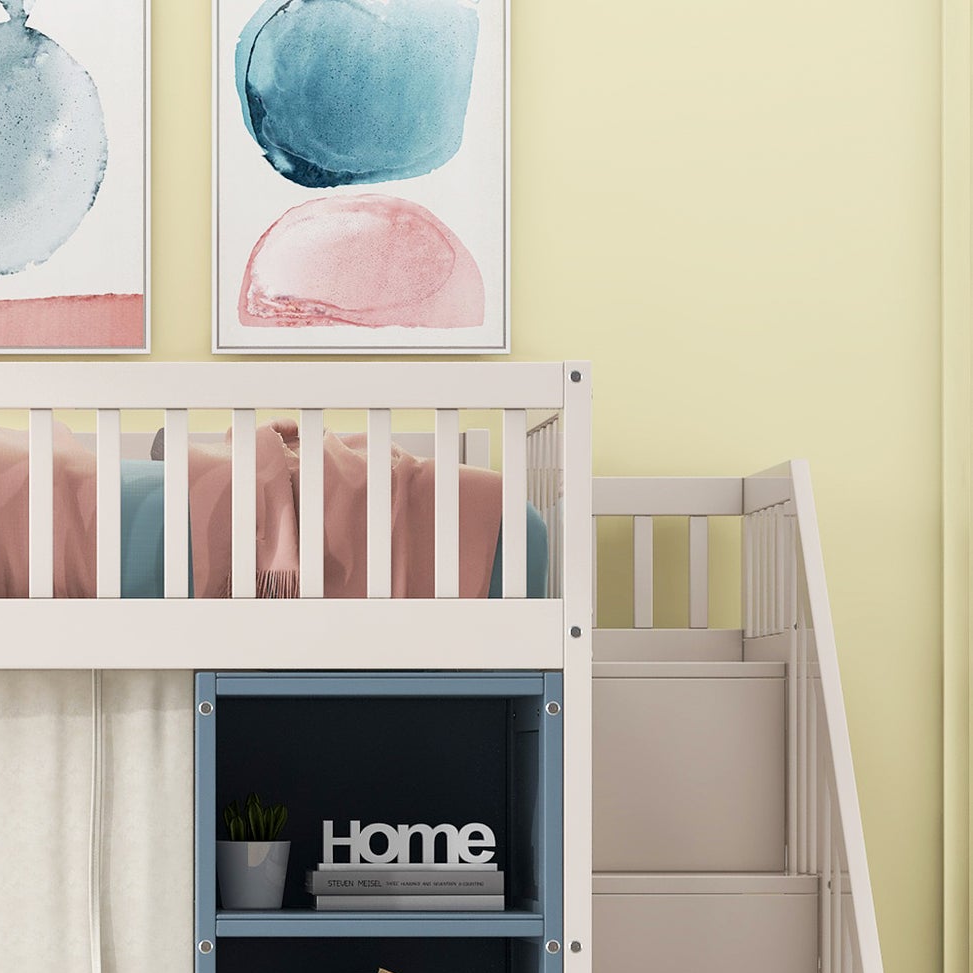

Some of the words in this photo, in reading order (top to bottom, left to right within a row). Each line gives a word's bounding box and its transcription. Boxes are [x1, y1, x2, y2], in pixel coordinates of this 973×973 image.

[323, 820, 496, 864] Home
[328, 879, 354, 888] STEVEN
[358, 879, 382, 888] MEISEL
